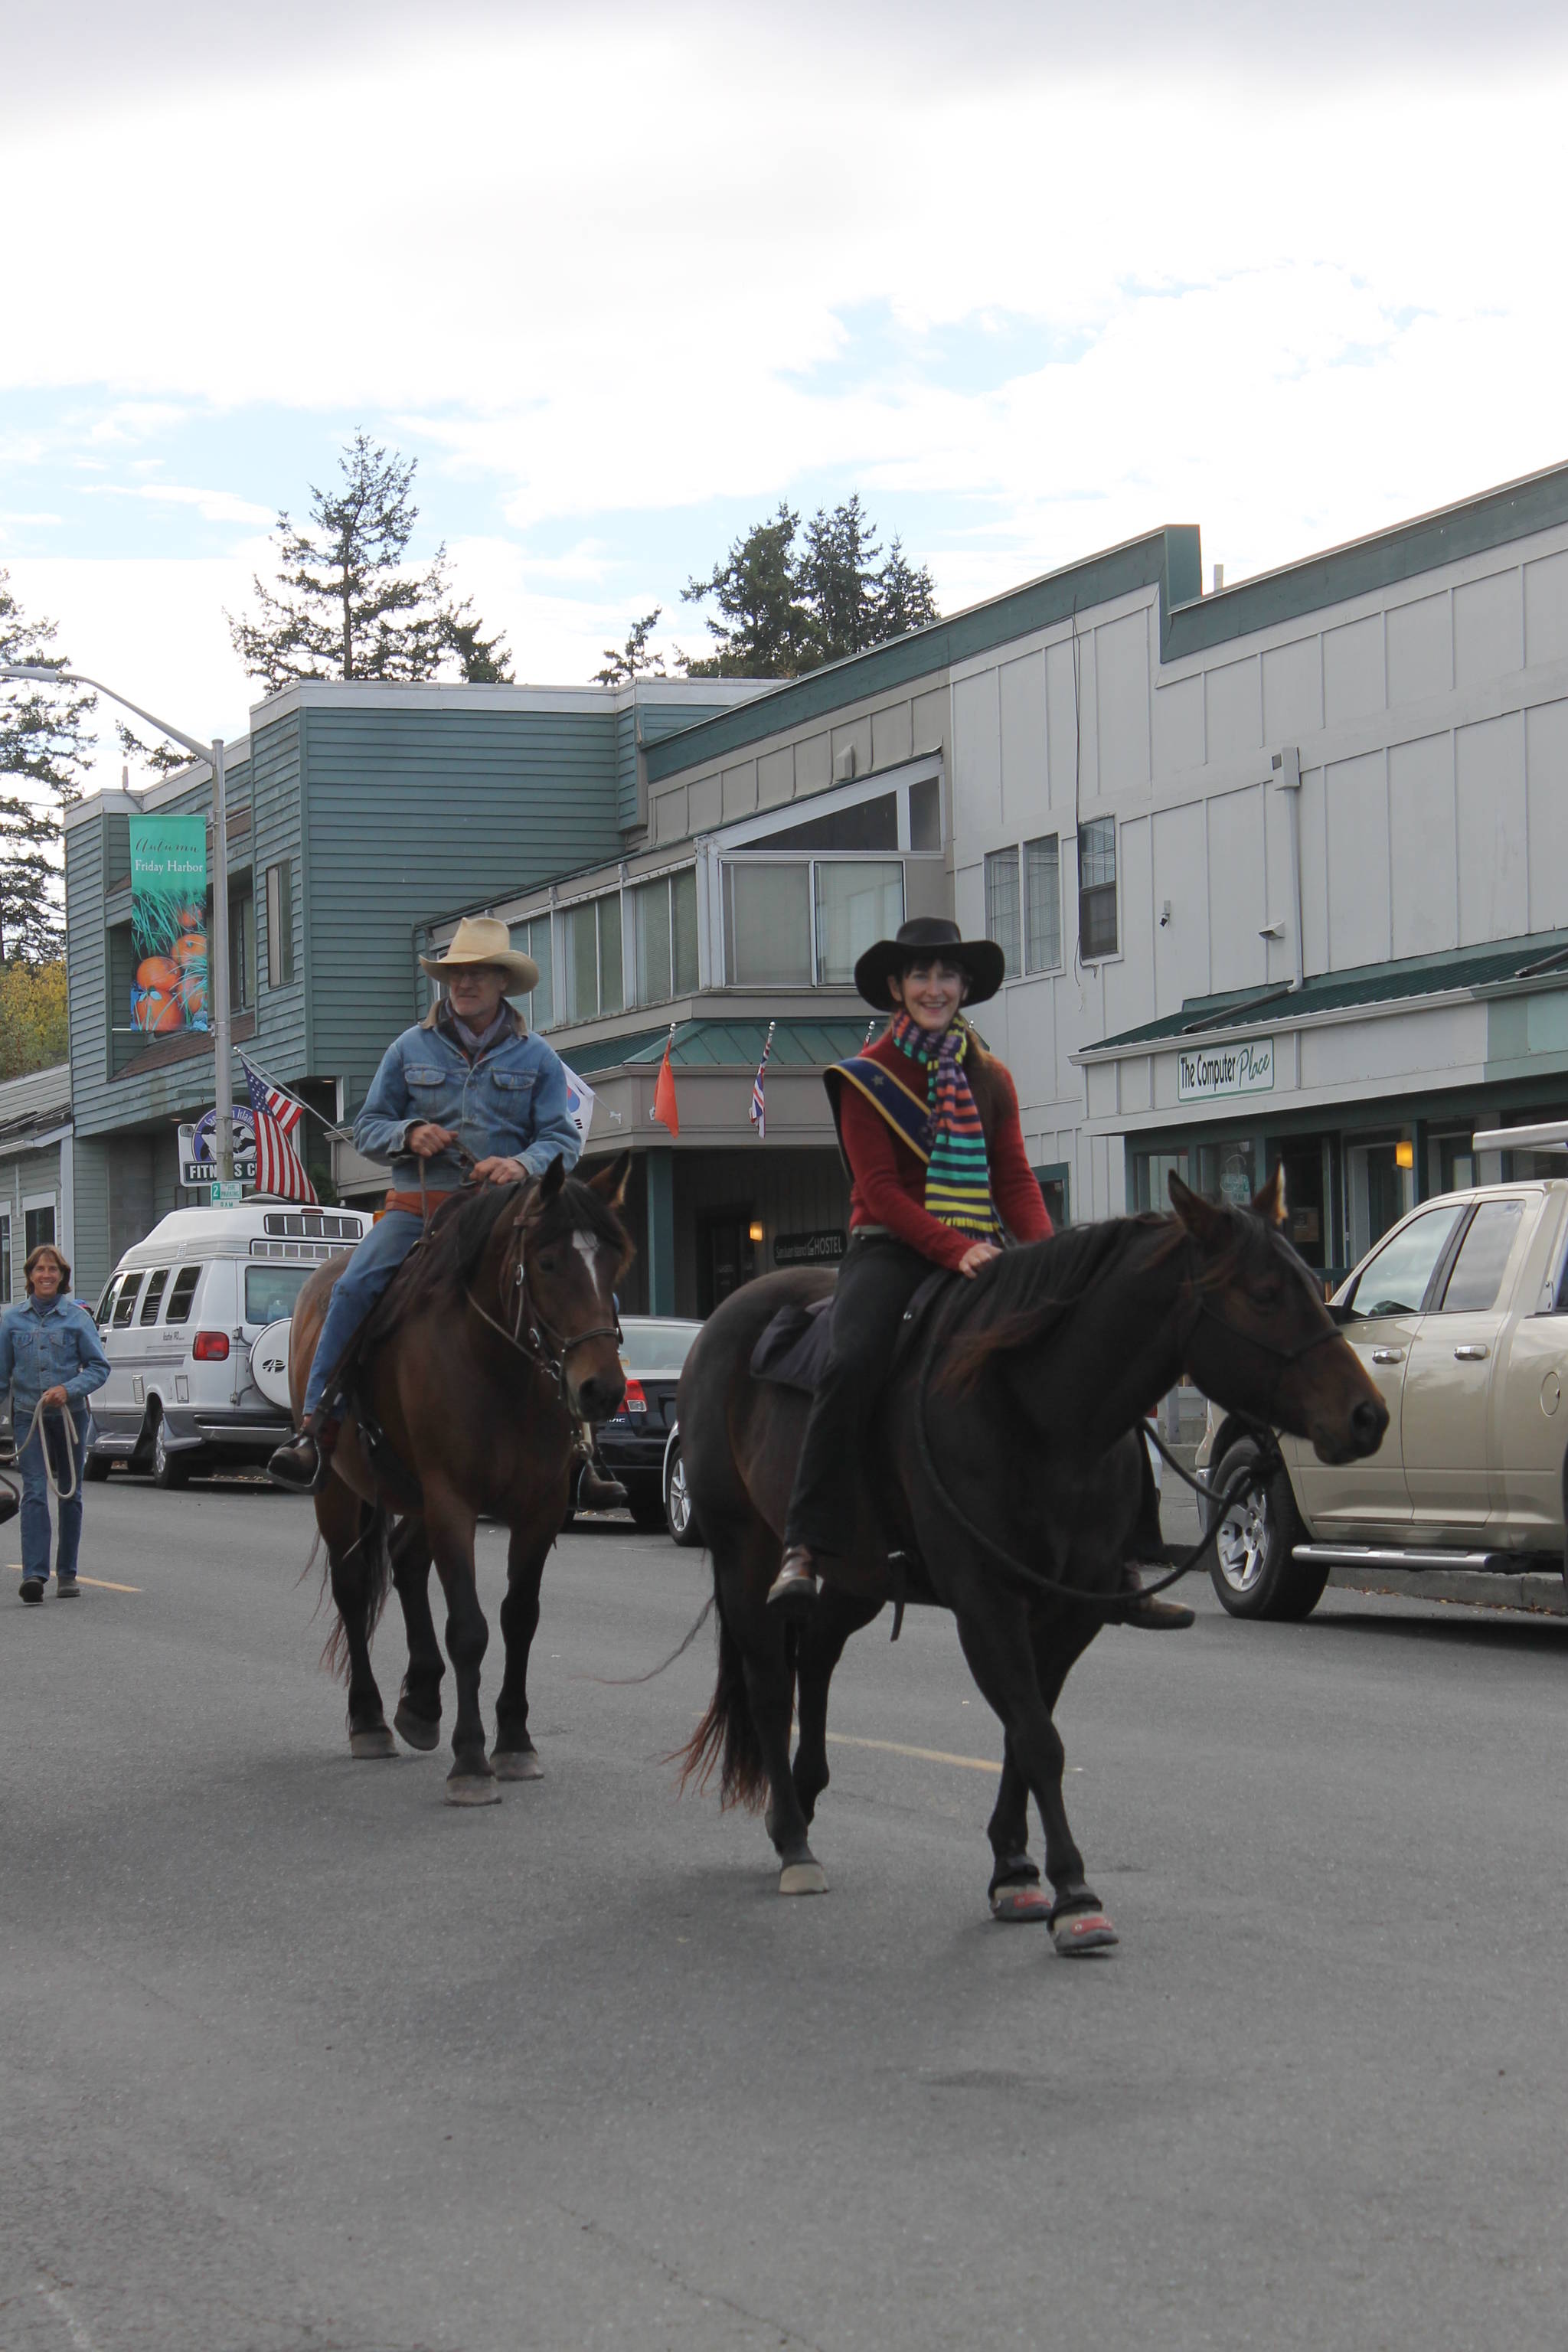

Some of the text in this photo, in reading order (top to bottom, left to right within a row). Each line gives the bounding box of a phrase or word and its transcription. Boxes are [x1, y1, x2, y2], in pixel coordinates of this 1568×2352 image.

[136, 838, 199, 852] Autumn
[135, 859, 203, 874] Friday Harbor
[1180, 1045, 1271, 1092] The Computer Place
[189, 1163, 243, 1179] FITNS
[213, 1185, 219, 1197] 2
[814, 1236, 842, 1256] HOSTEL
